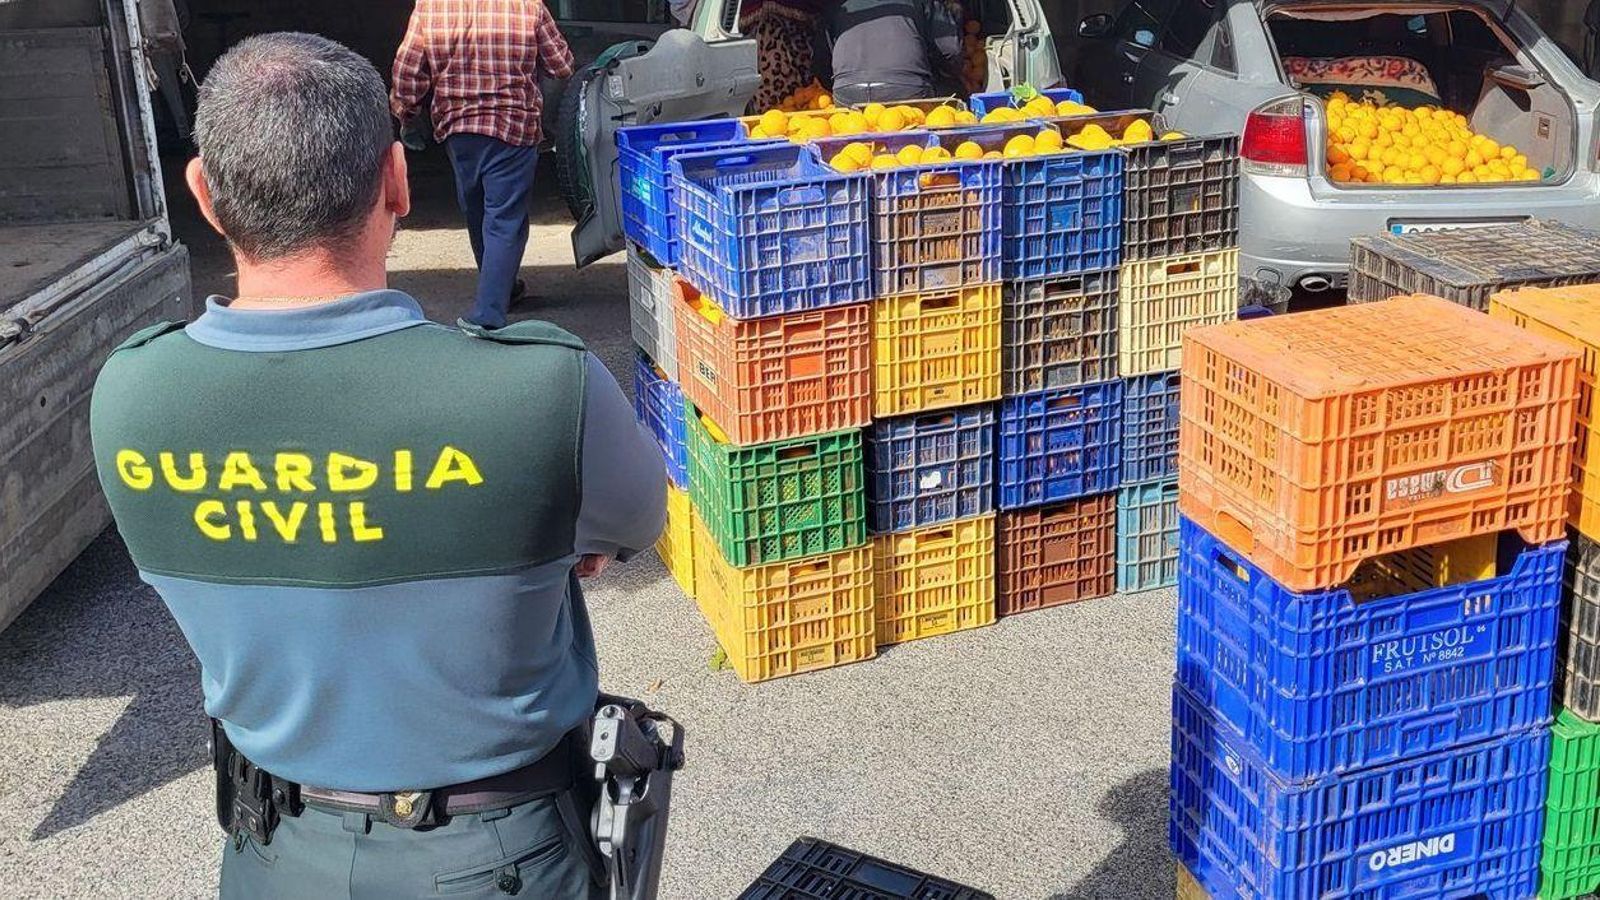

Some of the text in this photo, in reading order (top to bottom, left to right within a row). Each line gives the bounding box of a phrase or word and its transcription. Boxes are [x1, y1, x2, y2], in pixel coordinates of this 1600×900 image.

[117, 446, 484, 492] GUARDIA
[193, 500, 383, 542] CIVIL
[1438, 645, 1464, 660] 8842
[1369, 833, 1454, 870] DINERO
